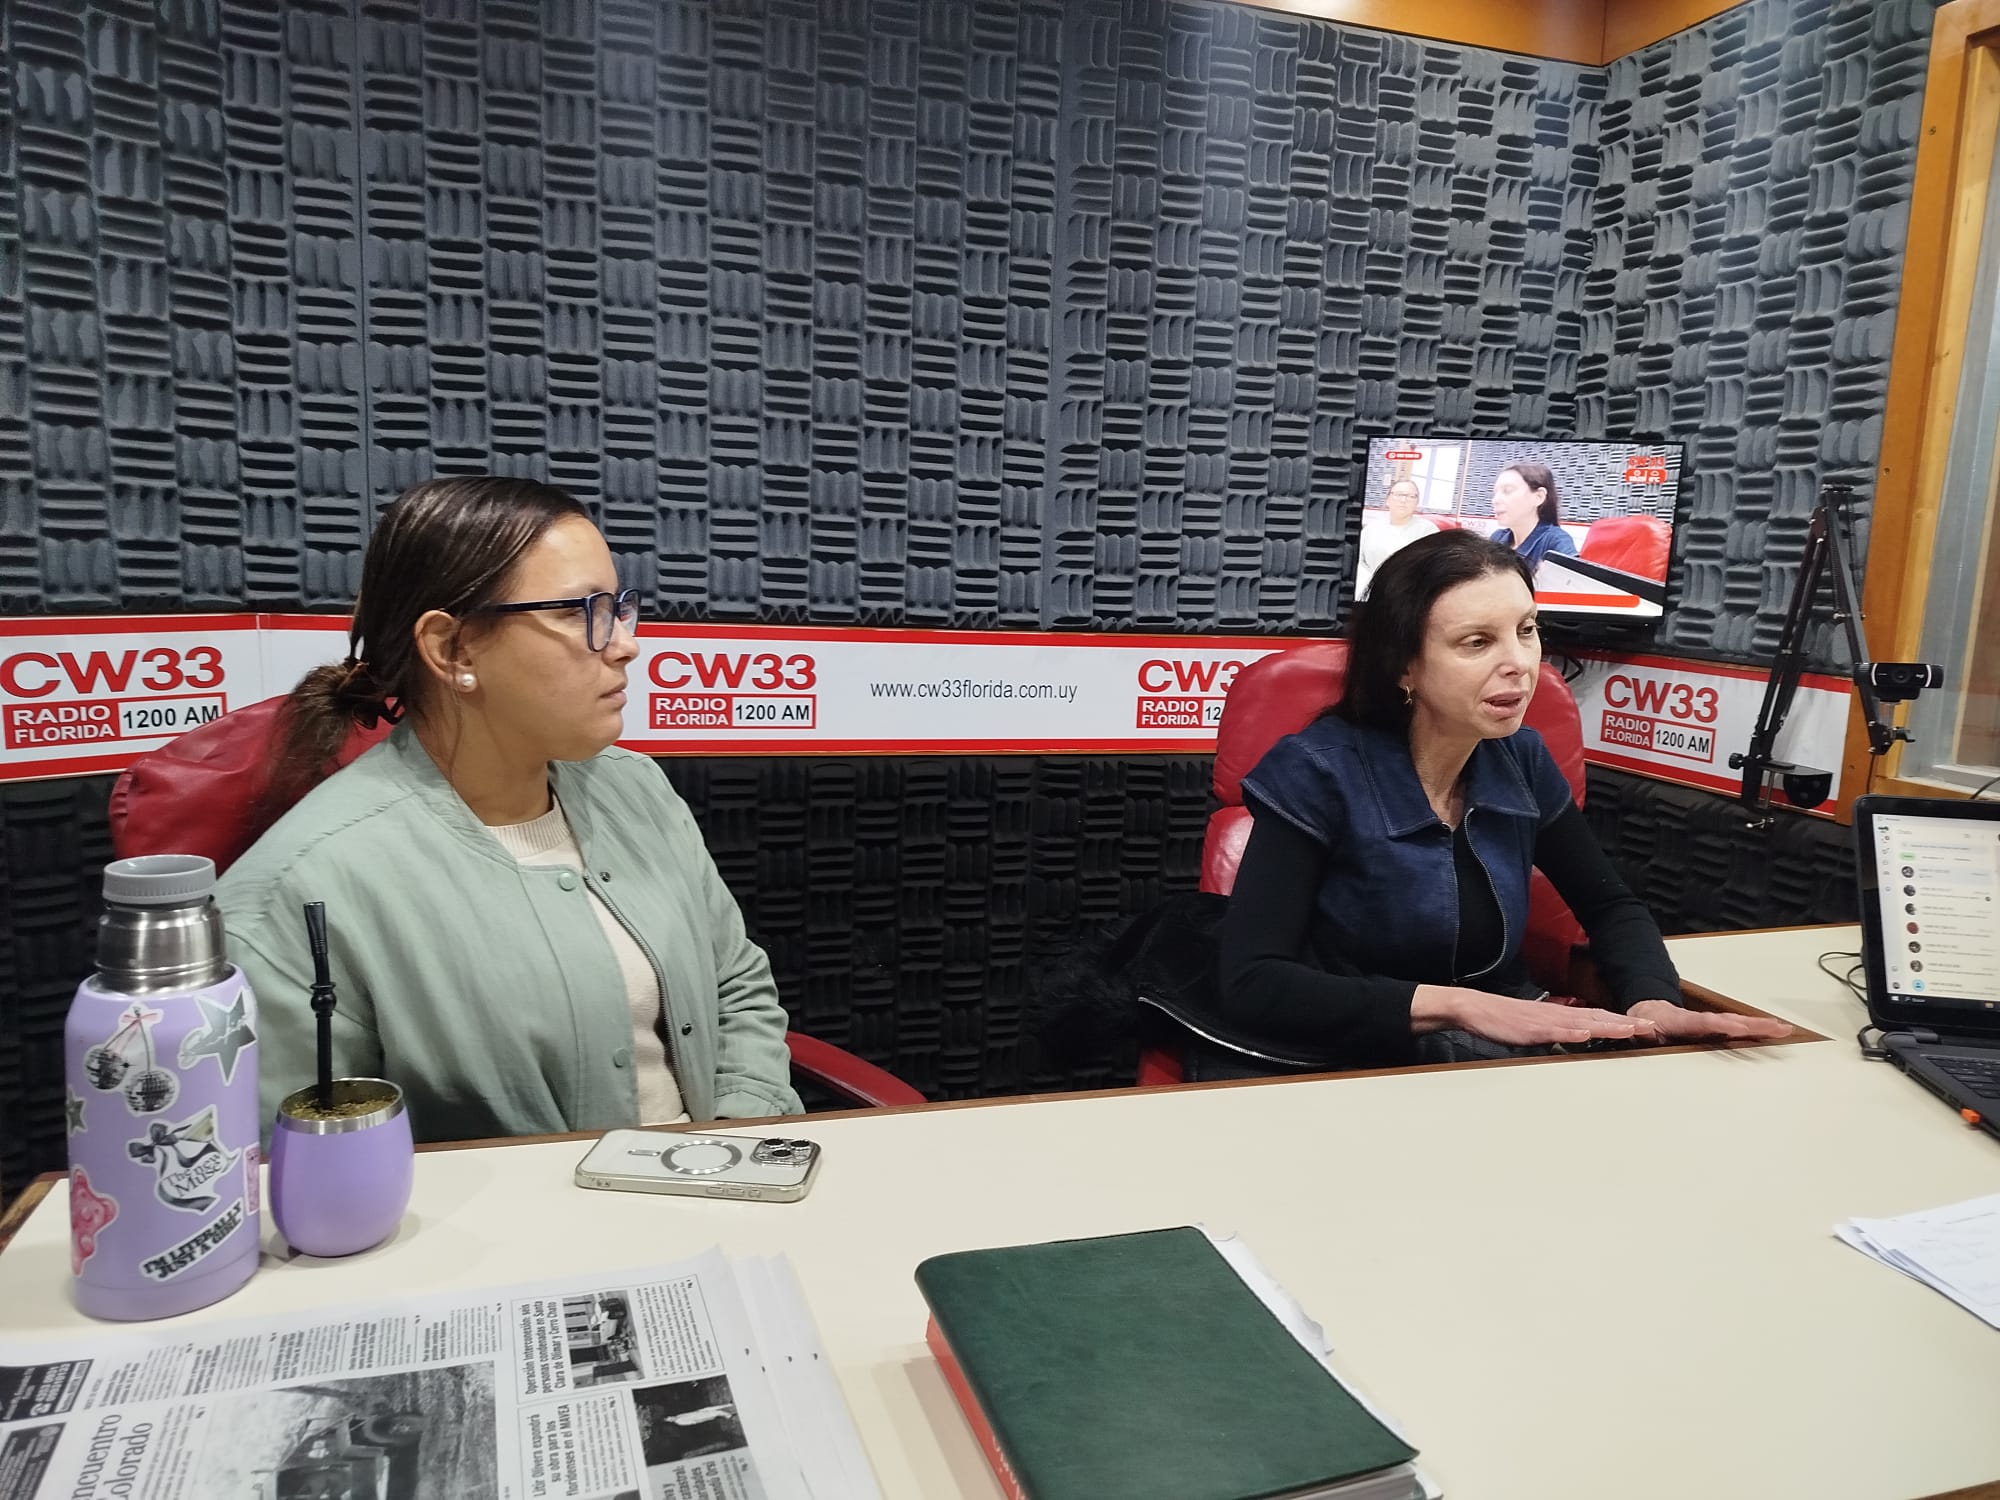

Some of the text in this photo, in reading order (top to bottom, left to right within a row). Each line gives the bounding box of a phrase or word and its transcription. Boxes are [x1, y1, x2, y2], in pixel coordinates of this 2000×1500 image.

[0, 647, 225, 698] CW33
[647, 651, 817, 690] CW33
[870, 679, 1078, 703] www.cw33florida.com.uy
[1604, 675, 1719, 723] CW33
[655, 697, 727, 711] RADIO
[735, 704, 810, 720] 1200 AM
[1142, 700, 1199, 713] RADIO
[12, 705, 110, 725] RADIO
[123, 705, 219, 730] 1200 AM
[655, 713, 729, 726] FLORIDA
[1141, 714, 1200, 726] FLORIDA
[1605, 715, 1650, 733] RADIO
[14, 725, 115, 744] FLORIDA
[1604, 730, 1650, 747] FLORIDA
[1655, 729, 1710, 754] 1200 AM
[66, 1414, 122, 1500] ncuentro
[100, 1422, 153, 1500] olorado
